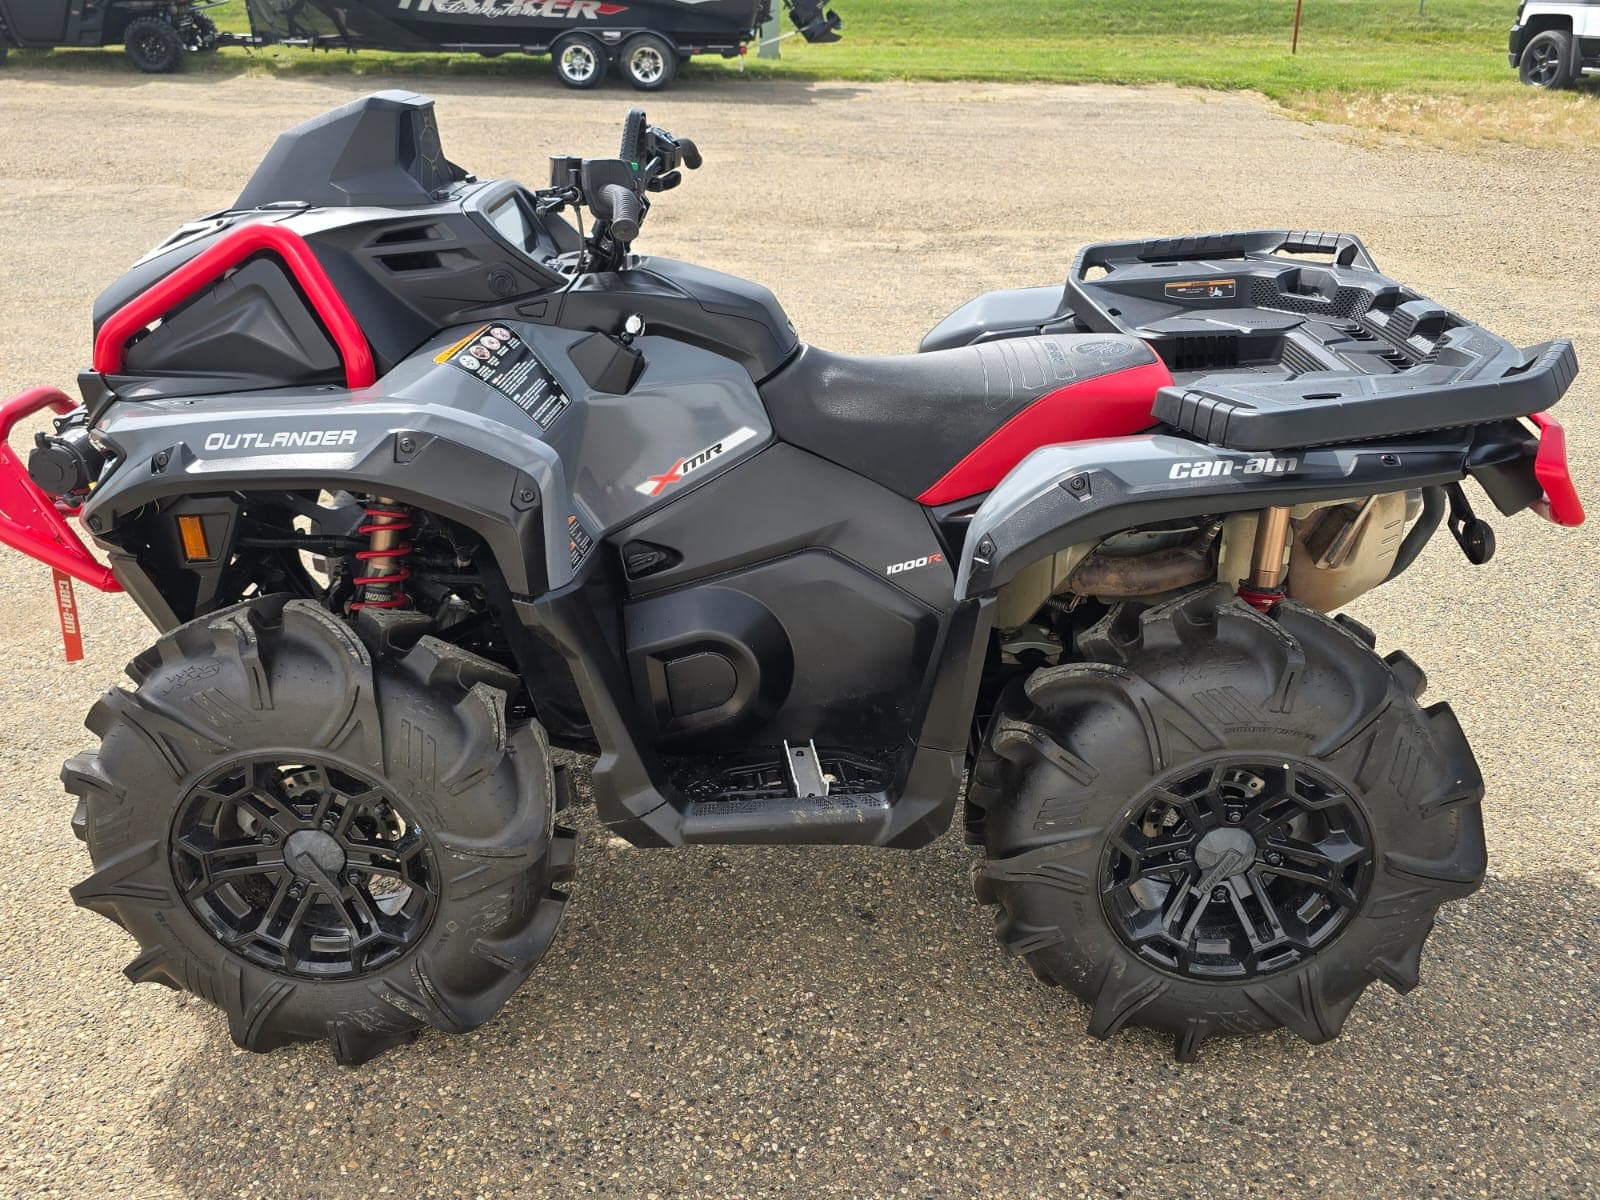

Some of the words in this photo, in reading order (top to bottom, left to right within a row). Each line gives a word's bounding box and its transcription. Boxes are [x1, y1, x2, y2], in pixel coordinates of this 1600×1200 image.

[204, 429, 358, 450] OUTLANDER
[1169, 457, 1298, 480] can-am
[58, 579, 76, 634] can-am
